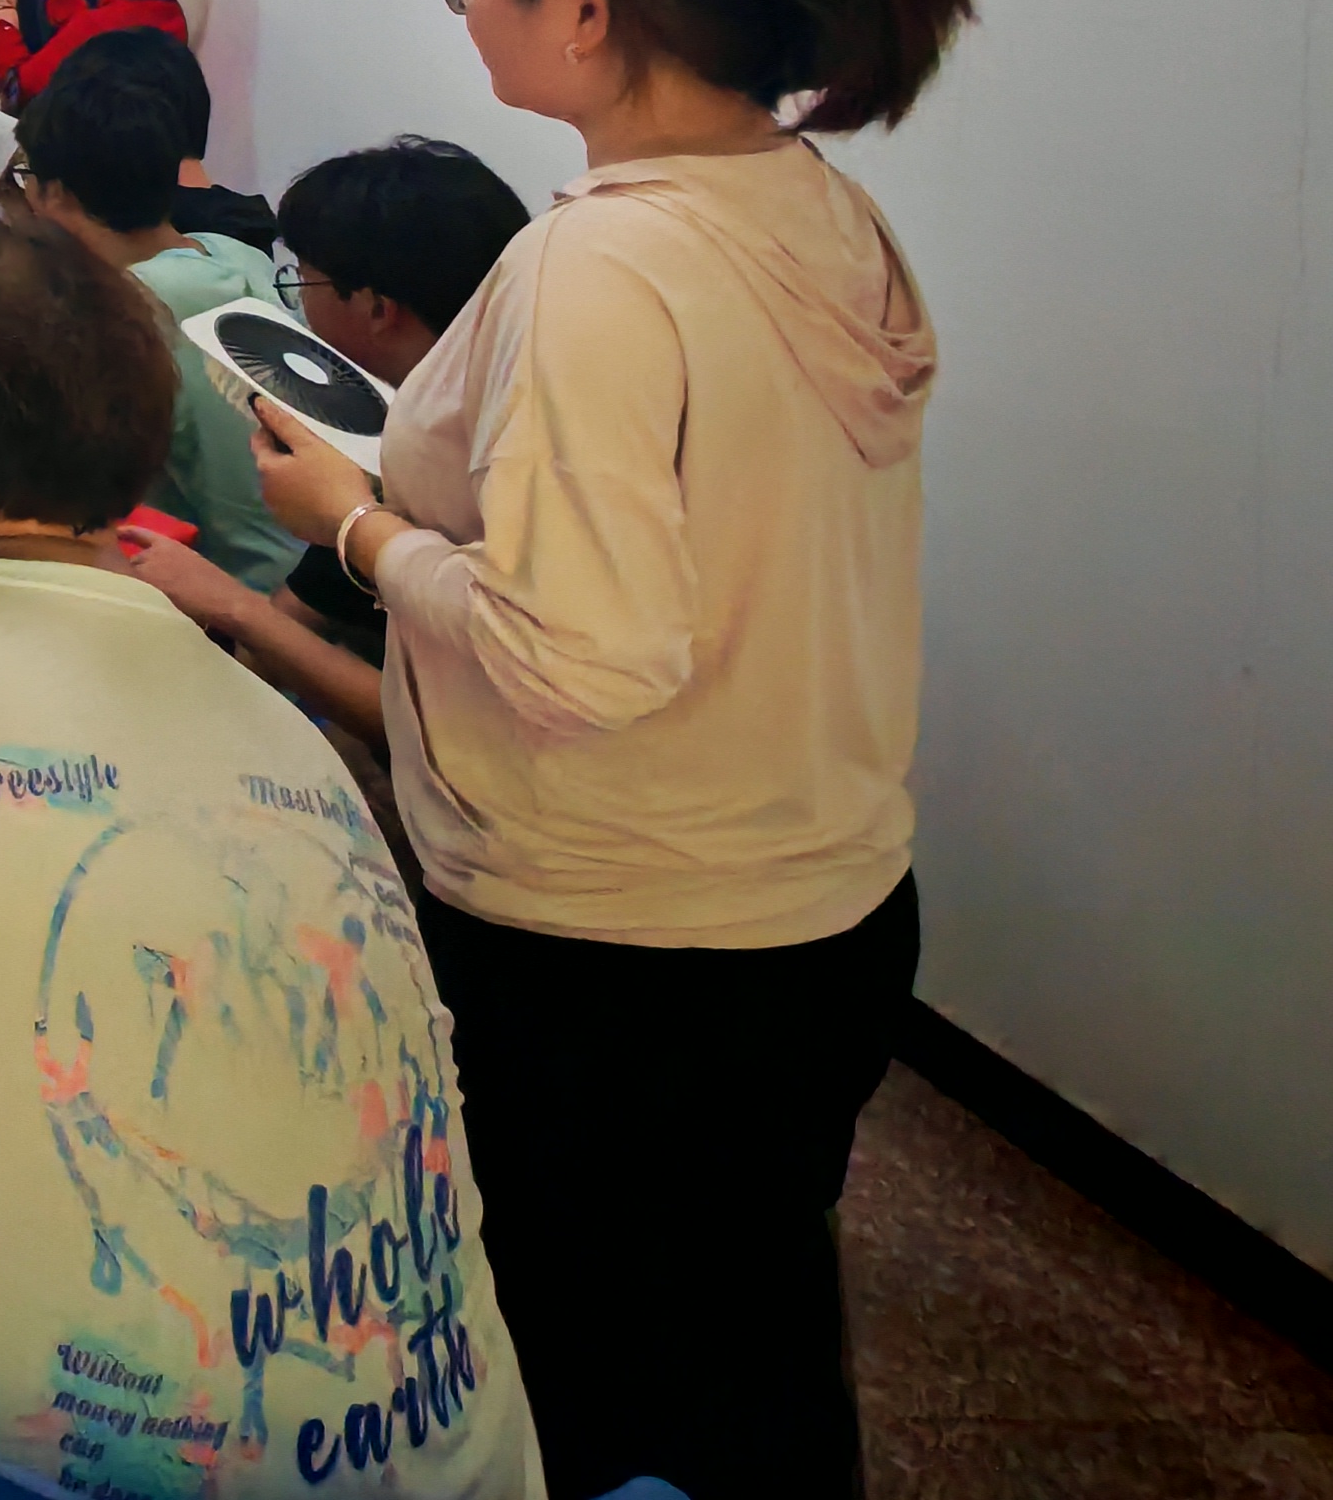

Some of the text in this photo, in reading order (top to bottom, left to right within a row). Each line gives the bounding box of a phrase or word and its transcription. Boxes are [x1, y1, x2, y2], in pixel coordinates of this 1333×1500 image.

[229, 1124, 461, 1369] whole
[52, 1391, 137, 1438] money
[296, 1272, 477, 1486] earth
